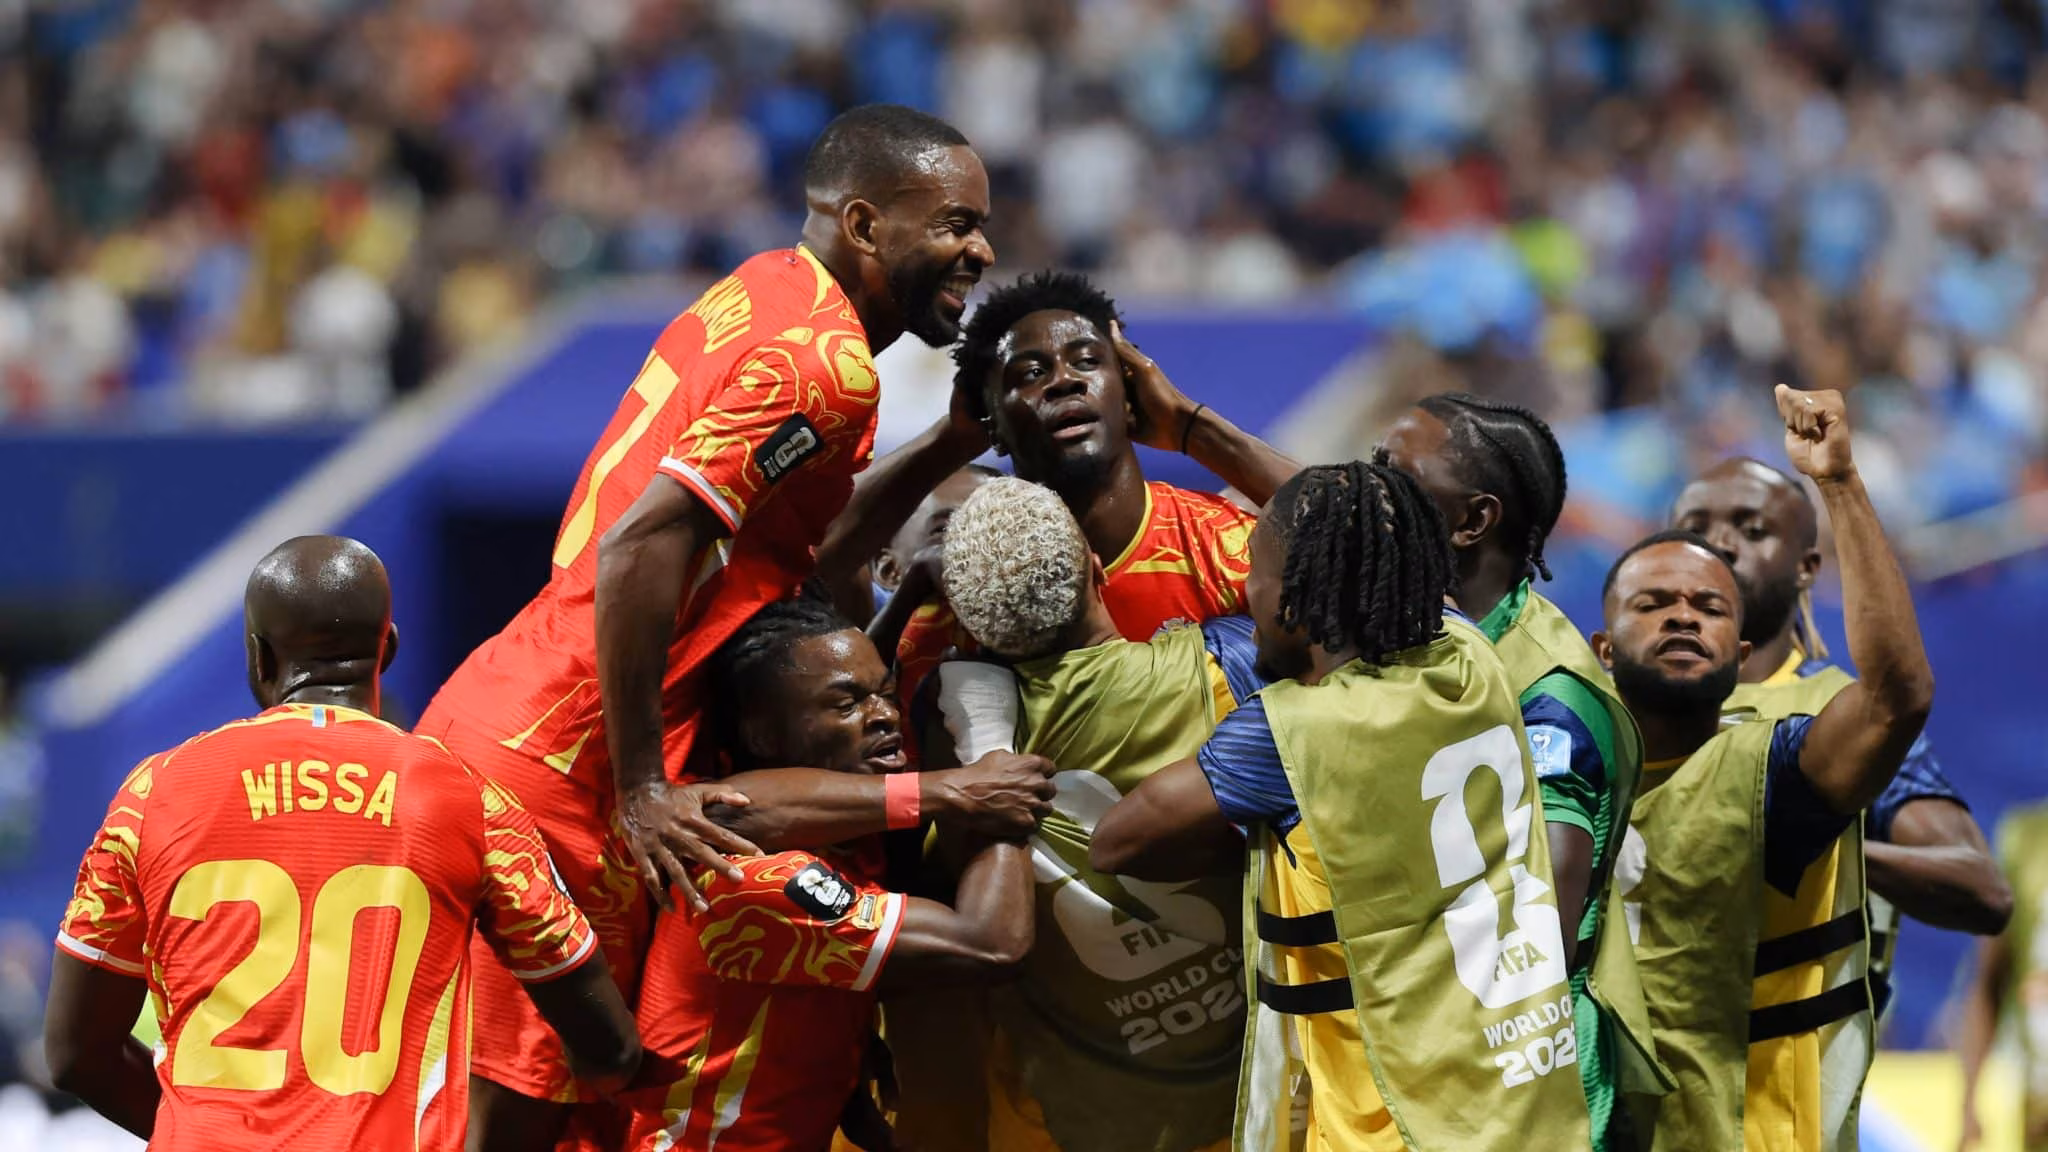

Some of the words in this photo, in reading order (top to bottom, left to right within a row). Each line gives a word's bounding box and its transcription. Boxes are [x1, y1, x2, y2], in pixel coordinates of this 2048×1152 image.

[553, 349, 680, 569] 7
[241, 760, 398, 828] WISSA
[1120, 926, 1173, 957] FI
[169, 859, 431, 1096] 20
[1103, 965, 1209, 1018] WORLD
[1211, 948, 1243, 974] CU
[1483, 1002, 1560, 1049] WORLD
[1494, 1021, 1577, 1089] 202
